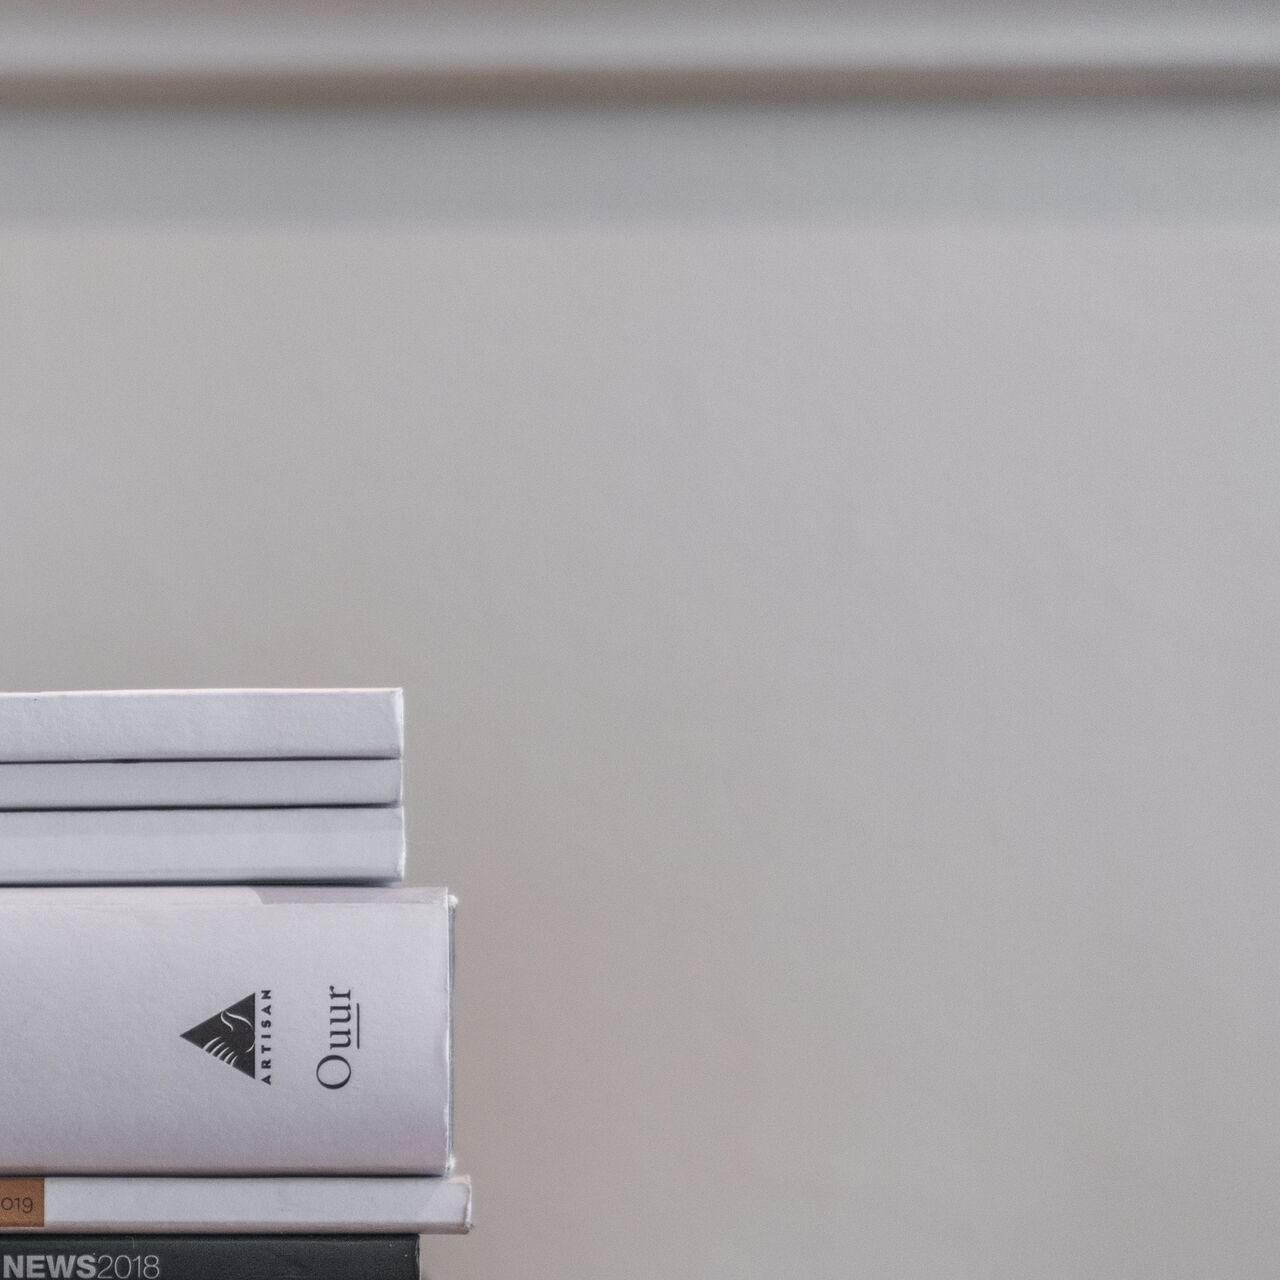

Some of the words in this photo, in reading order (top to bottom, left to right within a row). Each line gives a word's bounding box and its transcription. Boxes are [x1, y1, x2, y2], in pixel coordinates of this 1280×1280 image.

[260, 989, 272, 1086] ARTISAN
[316, 986, 355, 1090] Ouur
[2, 1254, 160, 1280] NEWS2018
